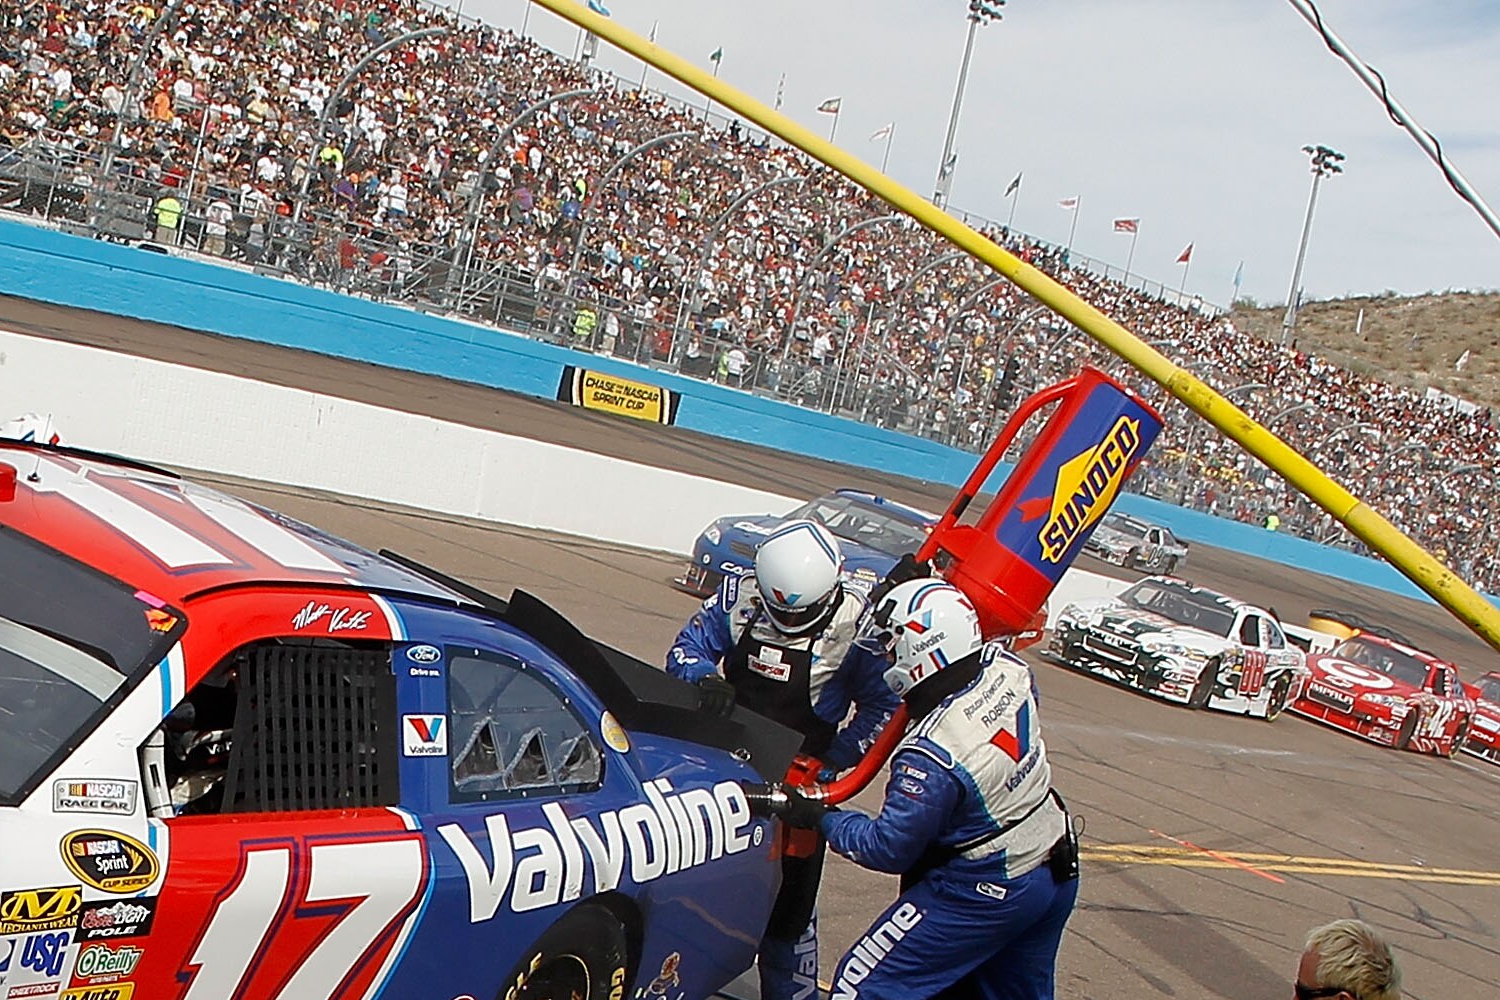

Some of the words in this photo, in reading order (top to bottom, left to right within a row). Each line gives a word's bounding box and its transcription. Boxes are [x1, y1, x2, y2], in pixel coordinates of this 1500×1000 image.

[585, 376, 617, 394] CHASE
[622, 385, 661, 404] NASCAR
[591, 391, 625, 409] SPRINT
[625, 398, 645, 412] CUP
[1043, 425, 1137, 557] SUNOCO
[912, 630, 948, 656] Valvoline
[908, 663, 925, 682] 17
[1309, 682, 1356, 705] IMPALA
[1429, 701, 1453, 739] 42
[86, 783, 124, 799] NASCAR
[101, 800, 130, 811] CAR
[86, 839, 121, 855] NASCAR
[437, 776, 751, 924] Valvoline
[95, 854, 131, 875] Sprint
[102, 878, 122, 889] CUP
[122, 876, 151, 887] SERIES
[49, 914, 79, 931] WEAR
[87, 925, 138, 939] POLE
[20, 931, 71, 978] USG
[78, 946, 142, 977] O'Reilly
[7, 981, 60, 998] SHEETROCK
